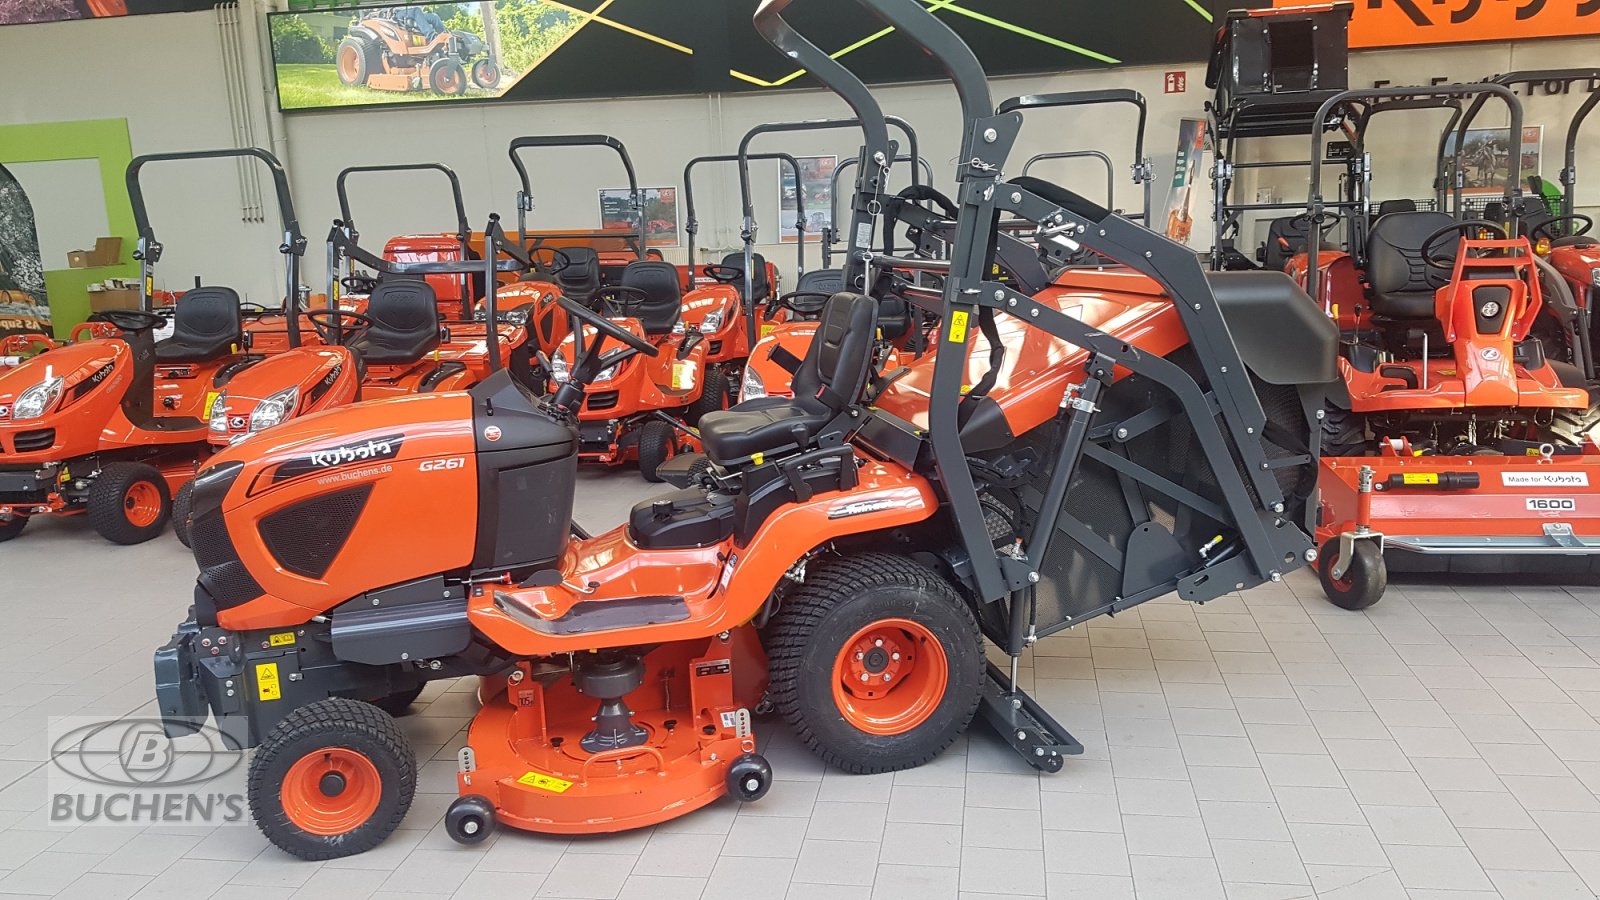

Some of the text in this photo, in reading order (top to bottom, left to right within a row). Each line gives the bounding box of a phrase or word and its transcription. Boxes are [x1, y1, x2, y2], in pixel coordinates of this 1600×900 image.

[311, 440, 392, 467] Kubota
[418, 457, 465, 472] G261
[316, 464, 393, 485] www.buchens.de
[1543, 475, 1582, 483] Kubota
[1529, 499, 1573, 509] 1600
